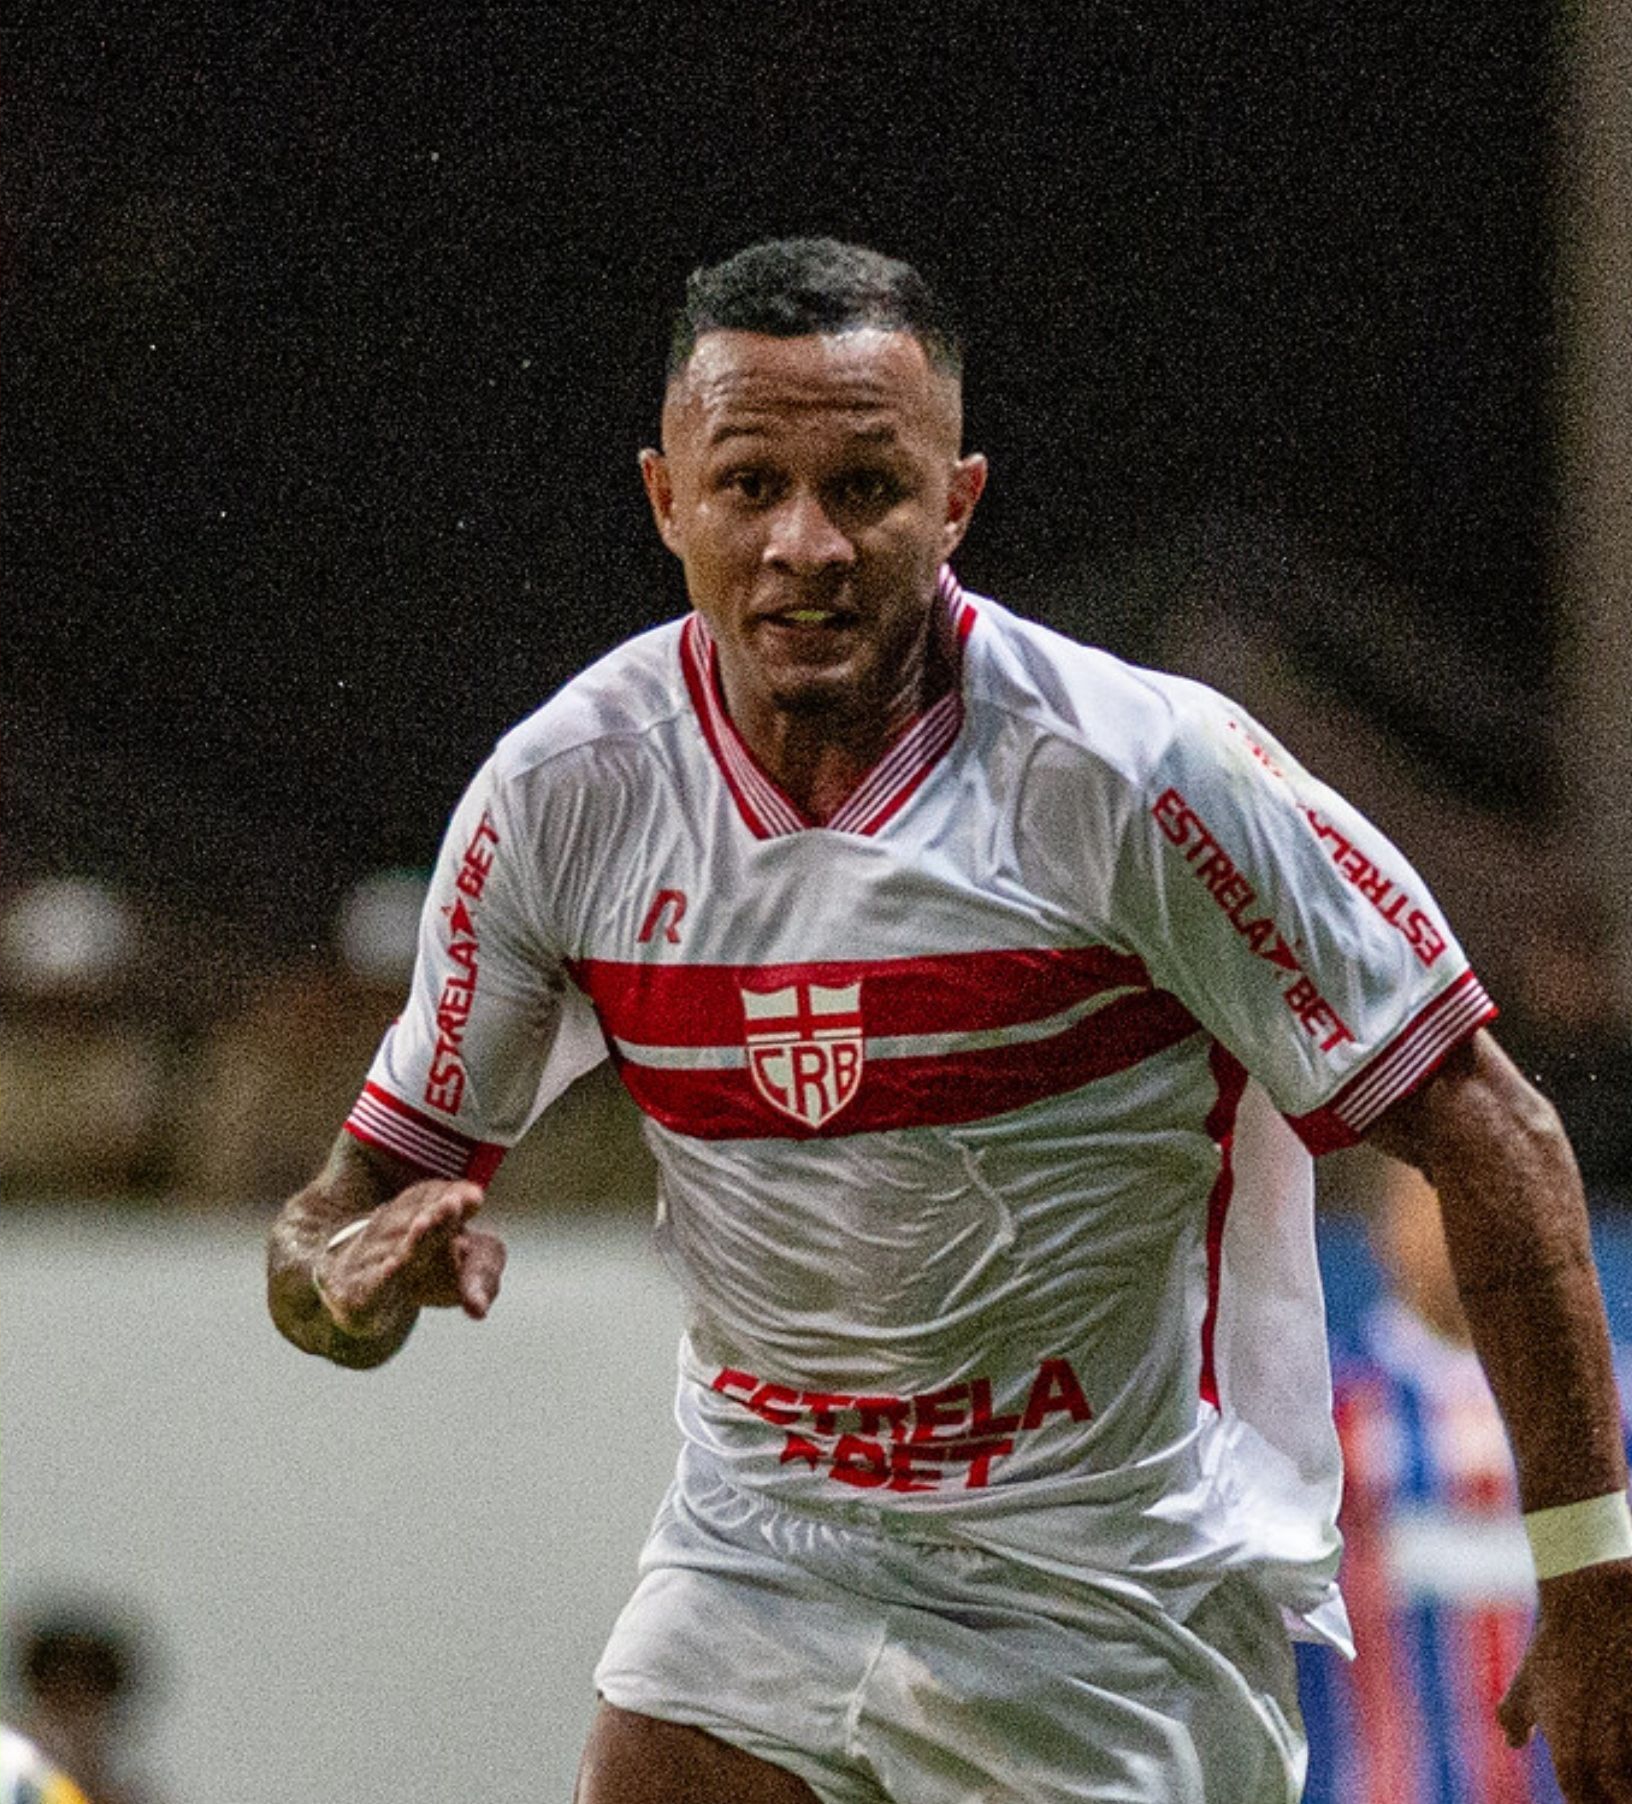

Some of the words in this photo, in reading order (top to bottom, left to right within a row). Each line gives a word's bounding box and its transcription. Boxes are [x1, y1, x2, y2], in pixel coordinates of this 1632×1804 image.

[424, 938, 480, 1116] ESTRELA
[456, 810, 500, 900] BET
[1151, 786, 1275, 952] ESTRELA
[1282, 974, 1356, 1052] BET
[1302, 806, 1448, 968] ESTREL
[752, 1043, 858, 1117] CRB
